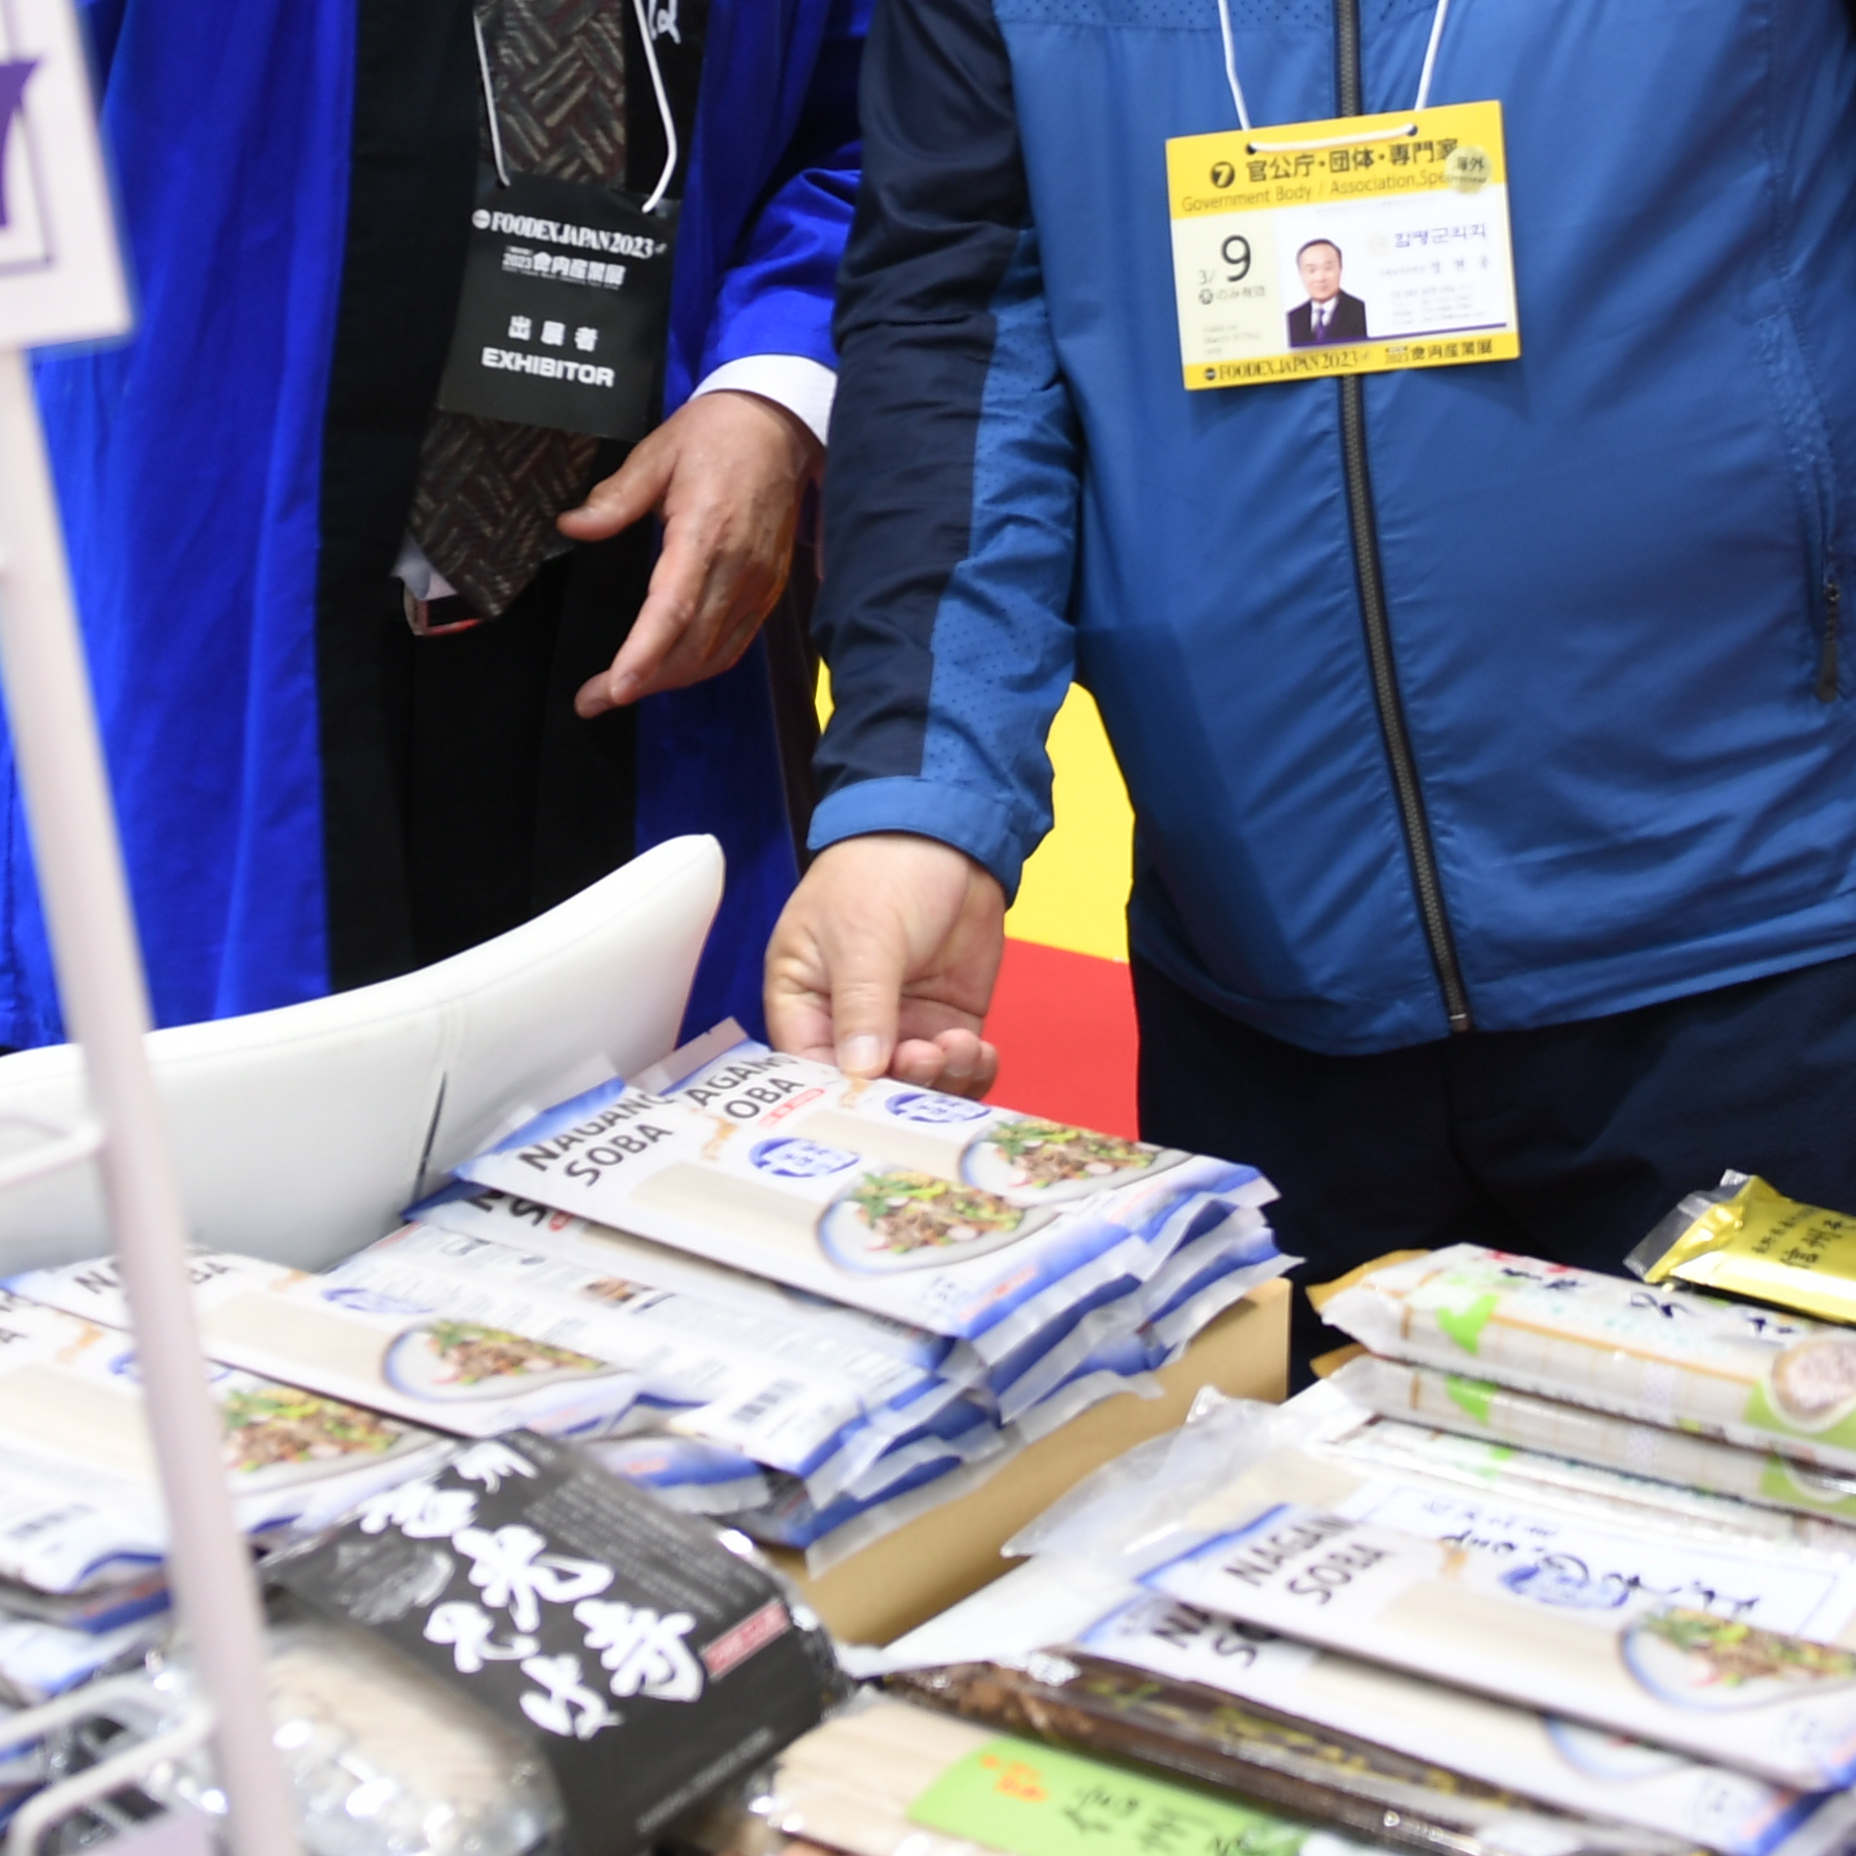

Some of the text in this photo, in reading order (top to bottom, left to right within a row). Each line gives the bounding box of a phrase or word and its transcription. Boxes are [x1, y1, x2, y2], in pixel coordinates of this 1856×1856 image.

[1181, 186, 1271, 213] Government
[1275, 182, 1312, 203] Body
[482, 347, 616, 388] EXHIBITOR
[684, 1054, 800, 1108] AGANO
[723, 1076, 807, 1120] OBA
[565, 1122, 674, 1188] SOBA
[1286, 1543, 1396, 1605] SOBA
